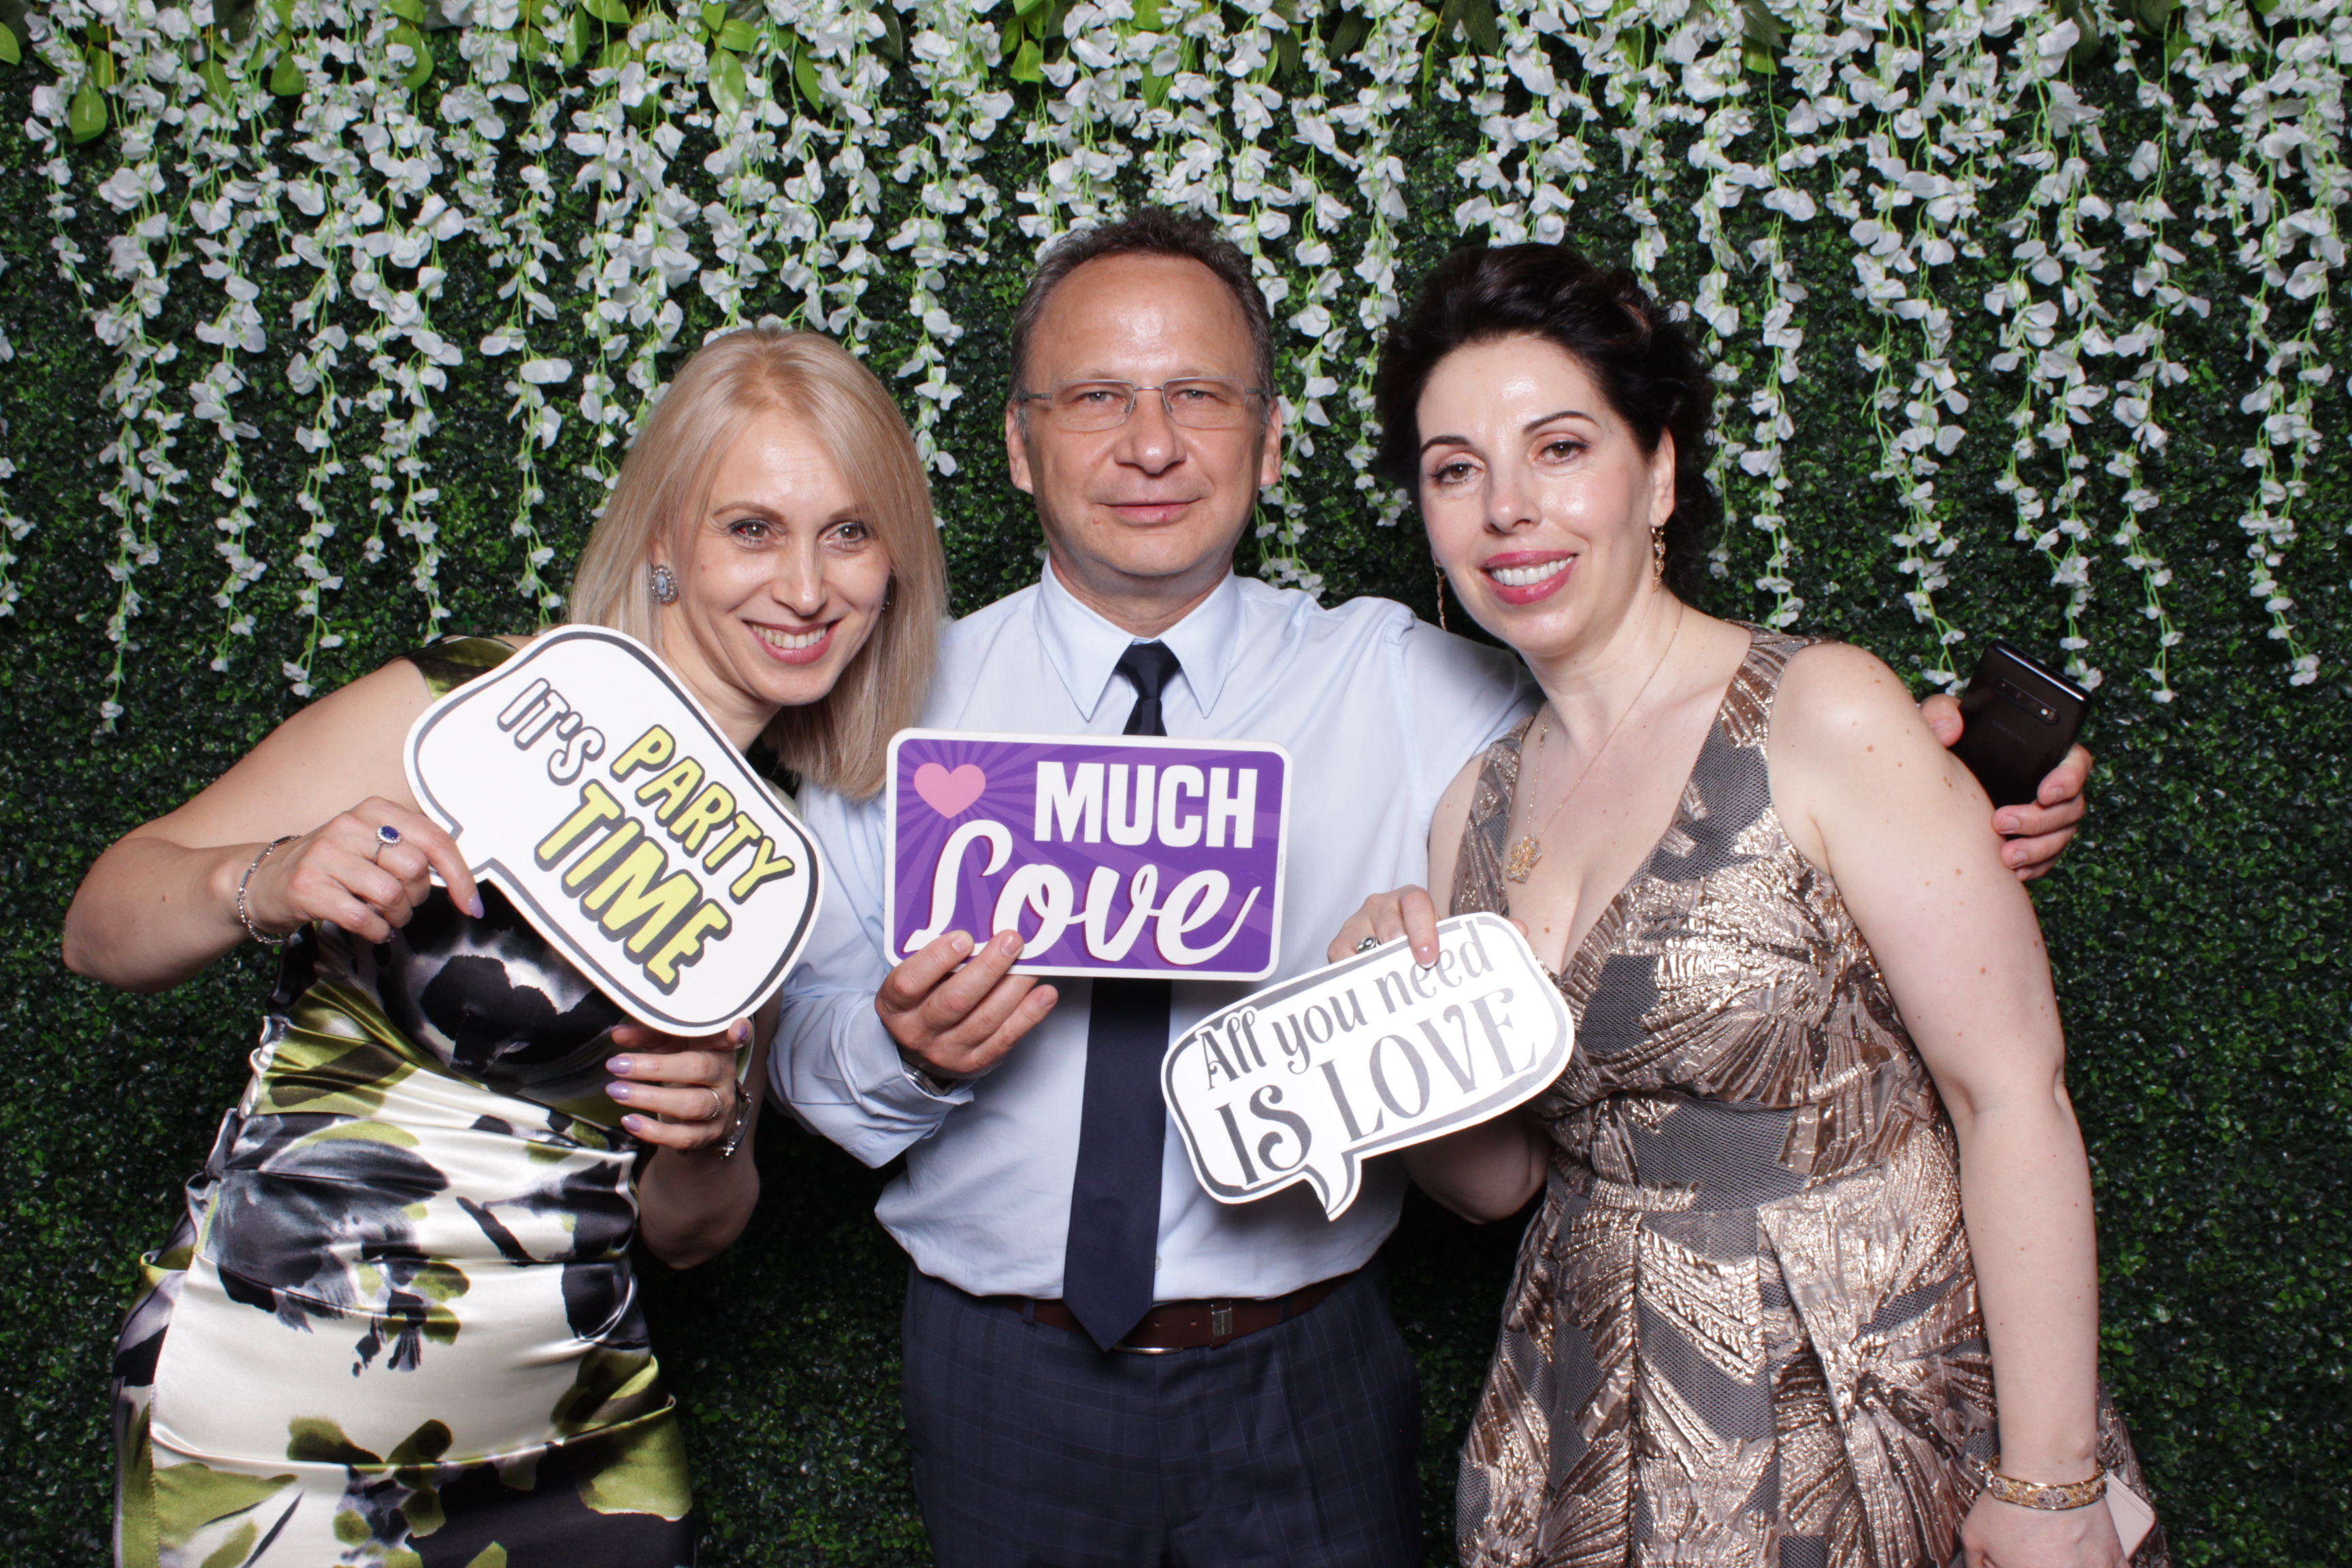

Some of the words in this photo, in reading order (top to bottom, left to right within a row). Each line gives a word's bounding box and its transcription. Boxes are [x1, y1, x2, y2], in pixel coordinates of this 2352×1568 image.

[497, 678, 605, 785] IT'S
[610, 724, 794, 905] PARTY
[1034, 761, 1258, 848] MUCH
[534, 779, 732, 995] TIME
[902, 819, 1261, 965] Love
[1198, 1010, 1267, 1090] All
[1271, 988, 1369, 1075] you
[1373, 919, 1494, 1014] need
[1215, 1085, 1312, 1186] IS
[1316, 987, 1537, 1143] LOVE
